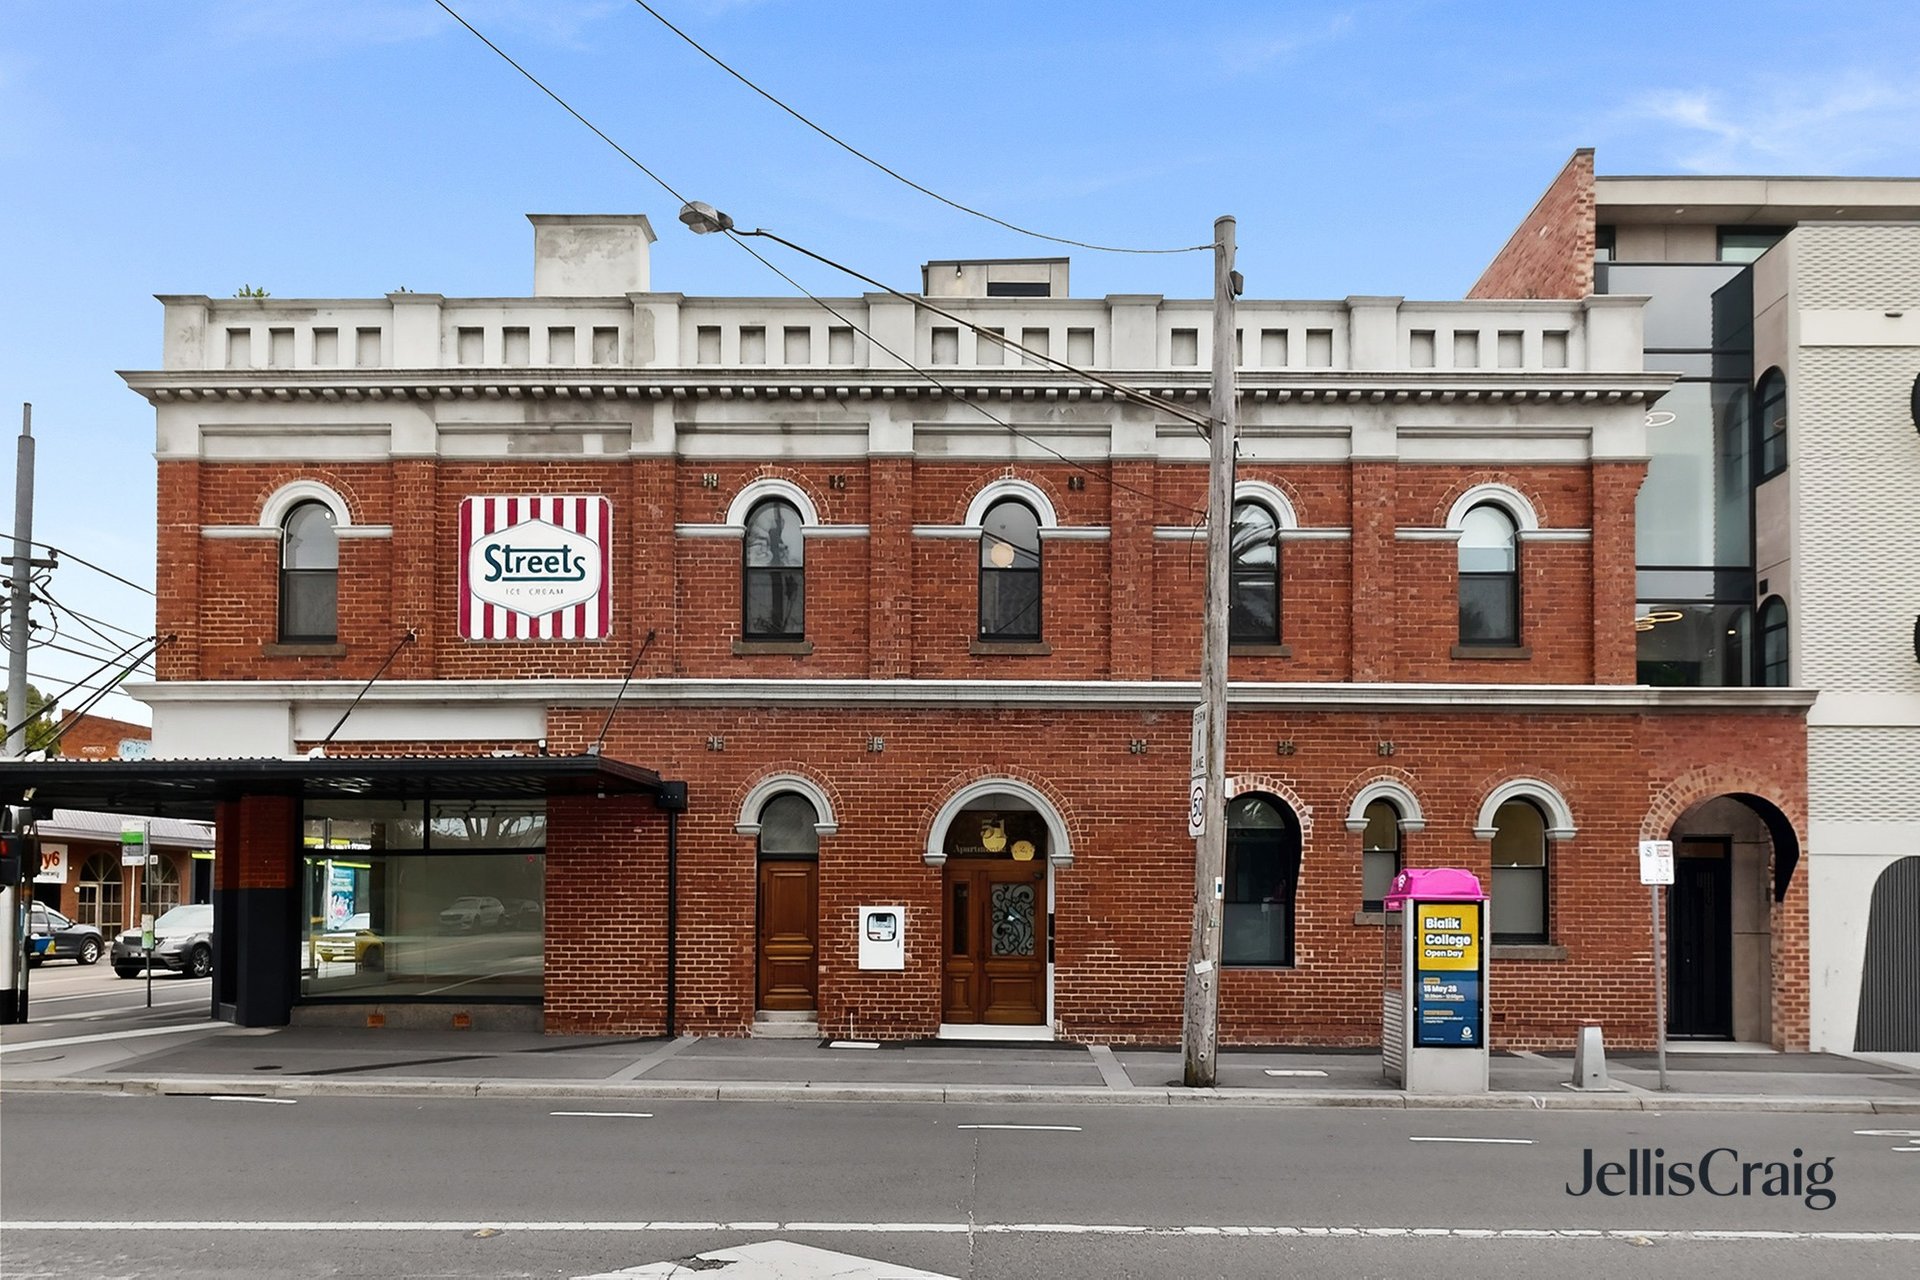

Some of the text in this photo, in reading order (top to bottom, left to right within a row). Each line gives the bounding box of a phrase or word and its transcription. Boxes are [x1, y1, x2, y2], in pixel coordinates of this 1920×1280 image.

[484, 544, 586, 582] Streets
[506, 588, 564, 596] ICE CREAM
[1193, 755, 1204, 772] LANE
[1193, 796, 1203, 818] 50
[1425, 917, 1460, 929] Bialik
[1425, 934, 1471, 947] College
[1425, 950, 1463, 958] Open Day
